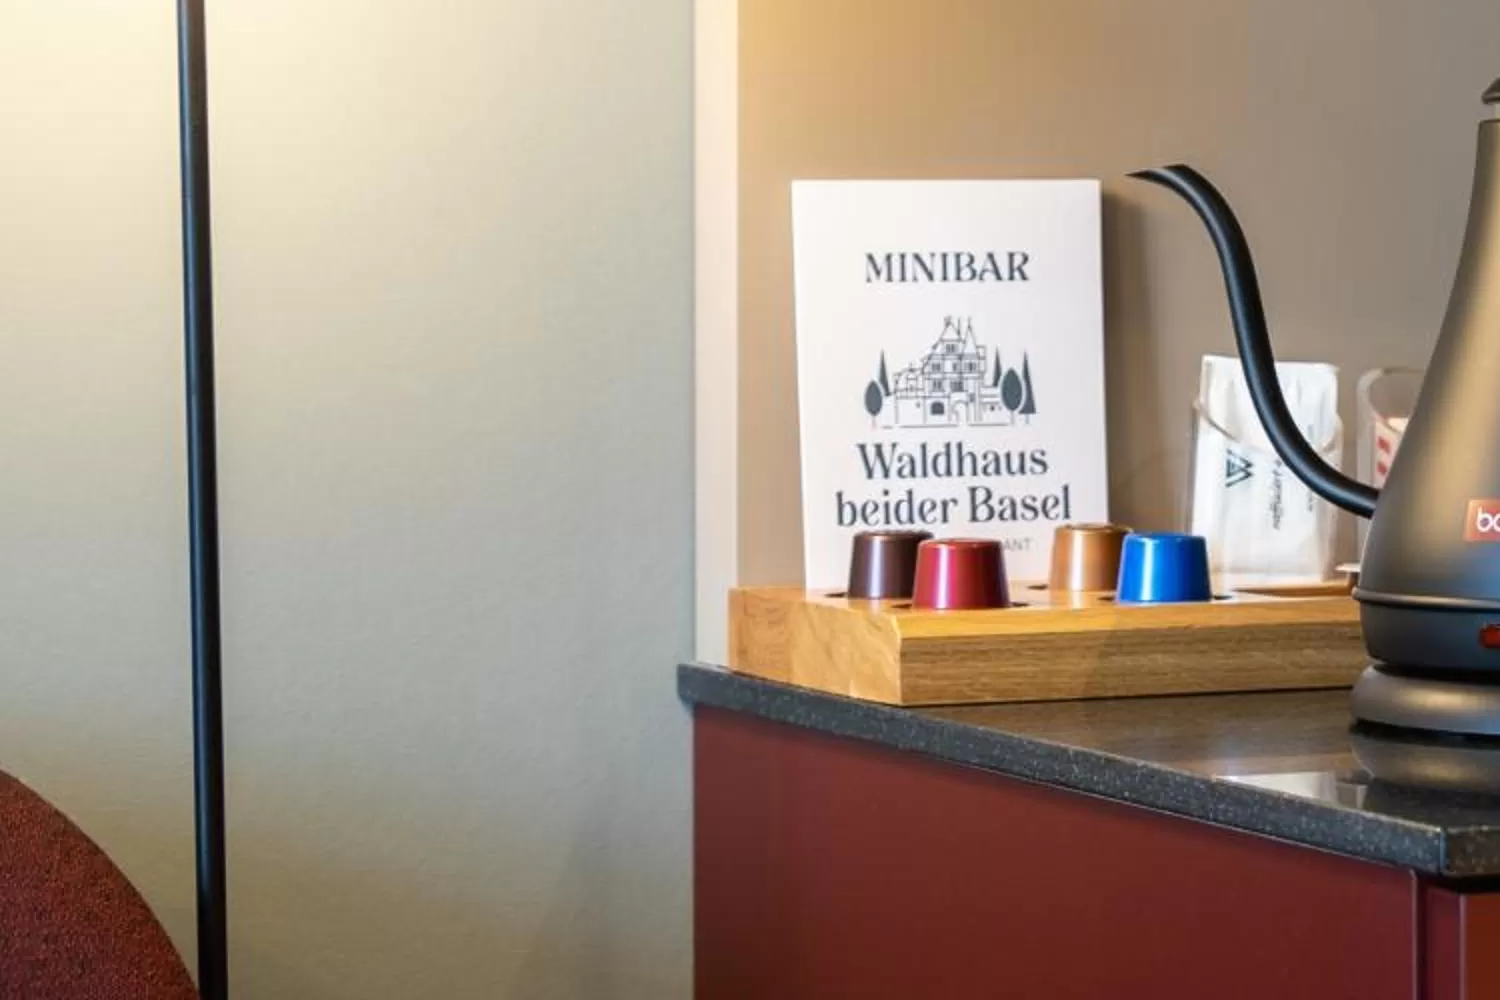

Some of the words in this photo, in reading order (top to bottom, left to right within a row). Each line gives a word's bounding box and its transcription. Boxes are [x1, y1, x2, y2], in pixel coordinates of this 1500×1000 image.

[864, 252, 1030, 284] MINIBAR
[856, 441, 1049, 480] Waldhaus
[836, 487, 958, 527] beider
[968, 483, 1071, 523] Basel
